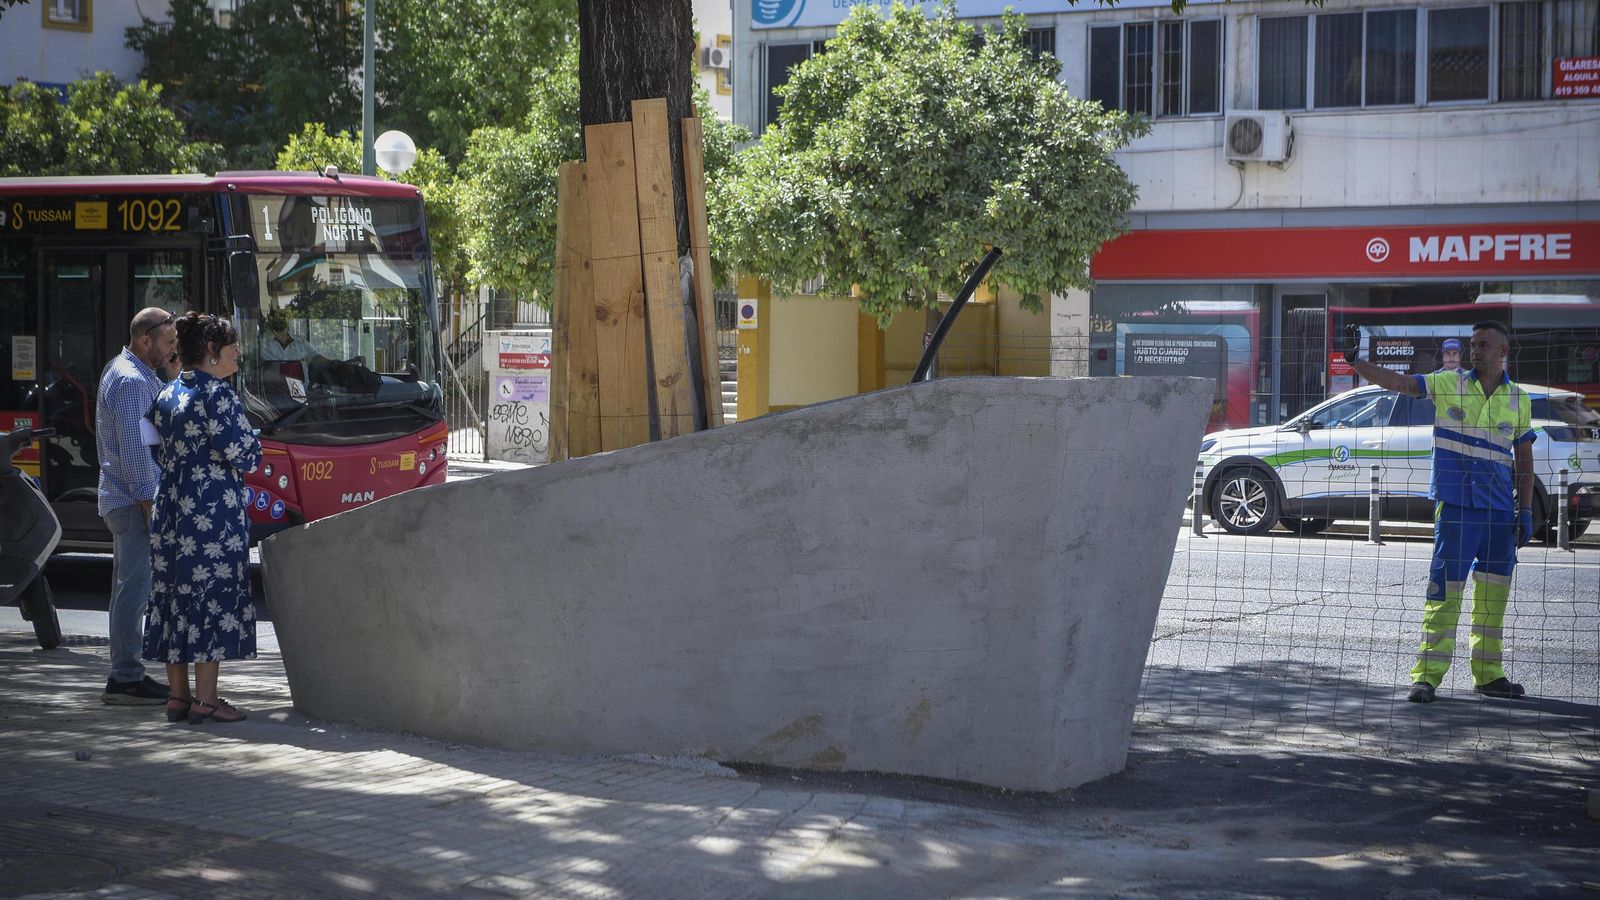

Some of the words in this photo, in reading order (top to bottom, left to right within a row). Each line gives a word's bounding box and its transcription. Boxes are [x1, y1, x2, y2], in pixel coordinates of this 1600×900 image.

[1564, 72, 1599, 82] ALQUILA
[27, 209, 72, 222] TUSSAM
[118, 199, 181, 231] 1092
[311, 206, 373, 224] POLIGONO
[262, 205, 273, 241] 1
[322, 224, 365, 241] NORTE
[1409, 233, 1572, 263] MAPFRE
[1134, 347, 1158, 355] JUSTO
[1159, 347, 1189, 356] CUANDO
[1376, 346, 1415, 356] COCHES
[1134, 355, 1143, 364] LO
[301, 460, 334, 481] 1092
[378, 459, 400, 469] TUSSAM
[341, 490, 375, 504] MAN
